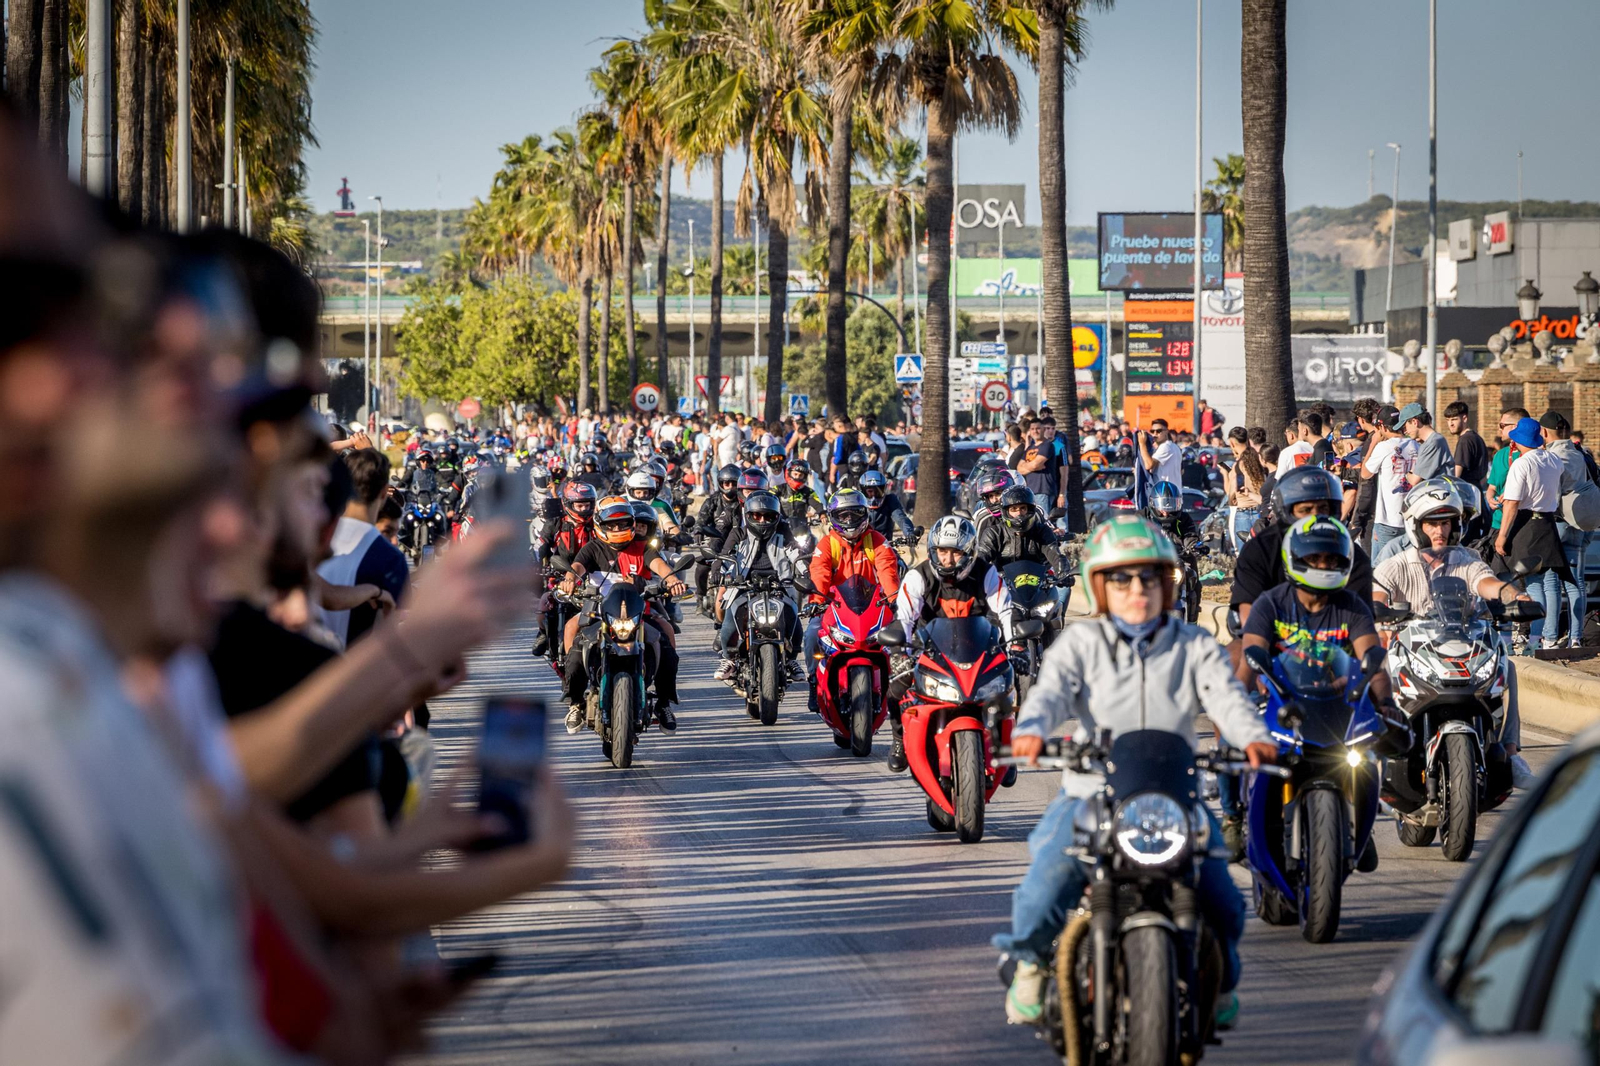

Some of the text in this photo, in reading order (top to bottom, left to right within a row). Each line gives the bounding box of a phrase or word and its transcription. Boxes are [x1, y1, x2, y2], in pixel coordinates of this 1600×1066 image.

[1111, 235, 1159, 248] Pruebe
[1104, 250, 1220, 267] puente de lavdo
[638, 393, 656, 404] 30
[987, 390, 1005, 402] 30
[1014, 574, 1039, 588] 23
